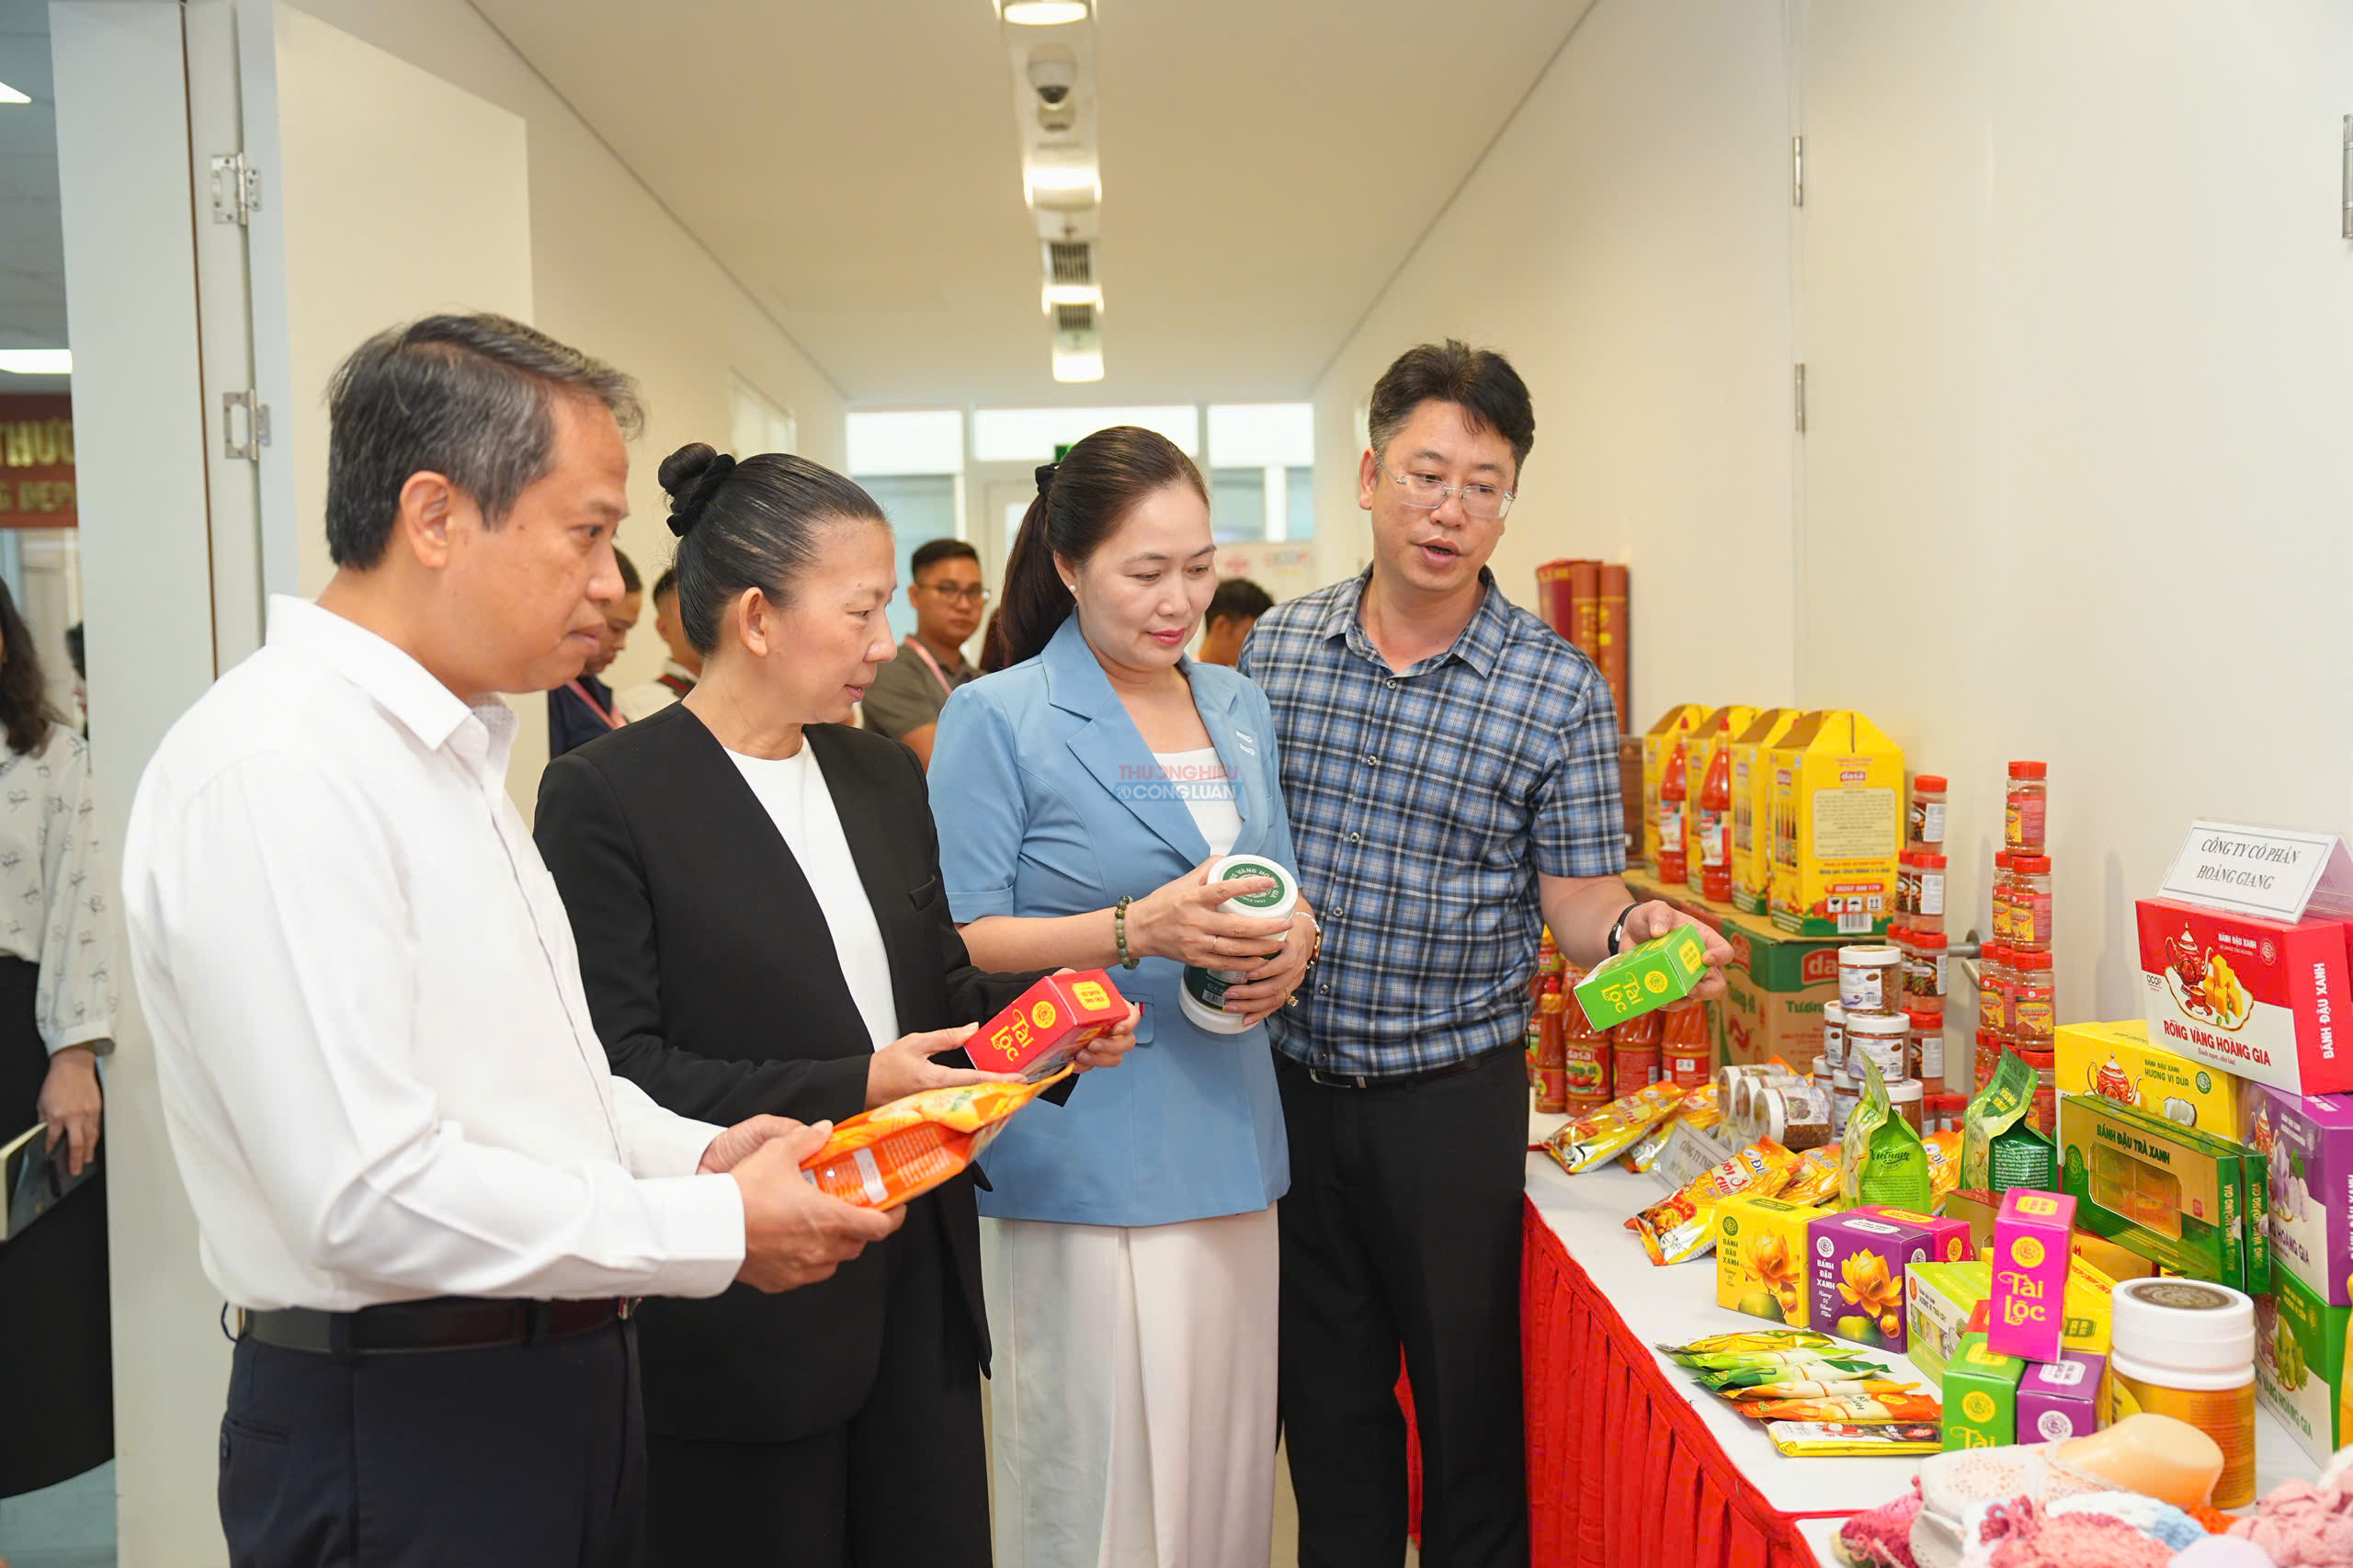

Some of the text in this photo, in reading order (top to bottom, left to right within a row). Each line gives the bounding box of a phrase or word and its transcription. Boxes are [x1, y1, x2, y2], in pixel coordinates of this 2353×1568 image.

[2201, 836, 2233, 855] CÔNG
[2233, 844, 2250, 857] TY
[2236, 872, 2276, 890] GIANG
[1808, 955, 1837, 975] da
[1623, 971, 1643, 1006] Tài
[2313, 962, 2335, 1059] BÁNH ĐẬU XANH
[1012, 1009, 1034, 1049] Tài
[2164, 1017, 2188, 1042] RỒNG
[2189, 1025, 2215, 1049] VÀNG
[2215, 1036, 2250, 1061] HOÀNG
[2252, 1047, 2271, 1066] GIA
[2097, 1123, 2170, 1165] BÁNH ĐẬU TRÀ XANH
[1722, 1256, 1740, 1267] XANH
[1816, 1258, 1835, 1270] BÁNH
[1816, 1278, 1836, 1290] XANH
[1819, 1269, 1833, 1279] ĐẬU
[1997, 1271, 2043, 1298] Tài
[2004, 1295, 2046, 1325] Lộc
